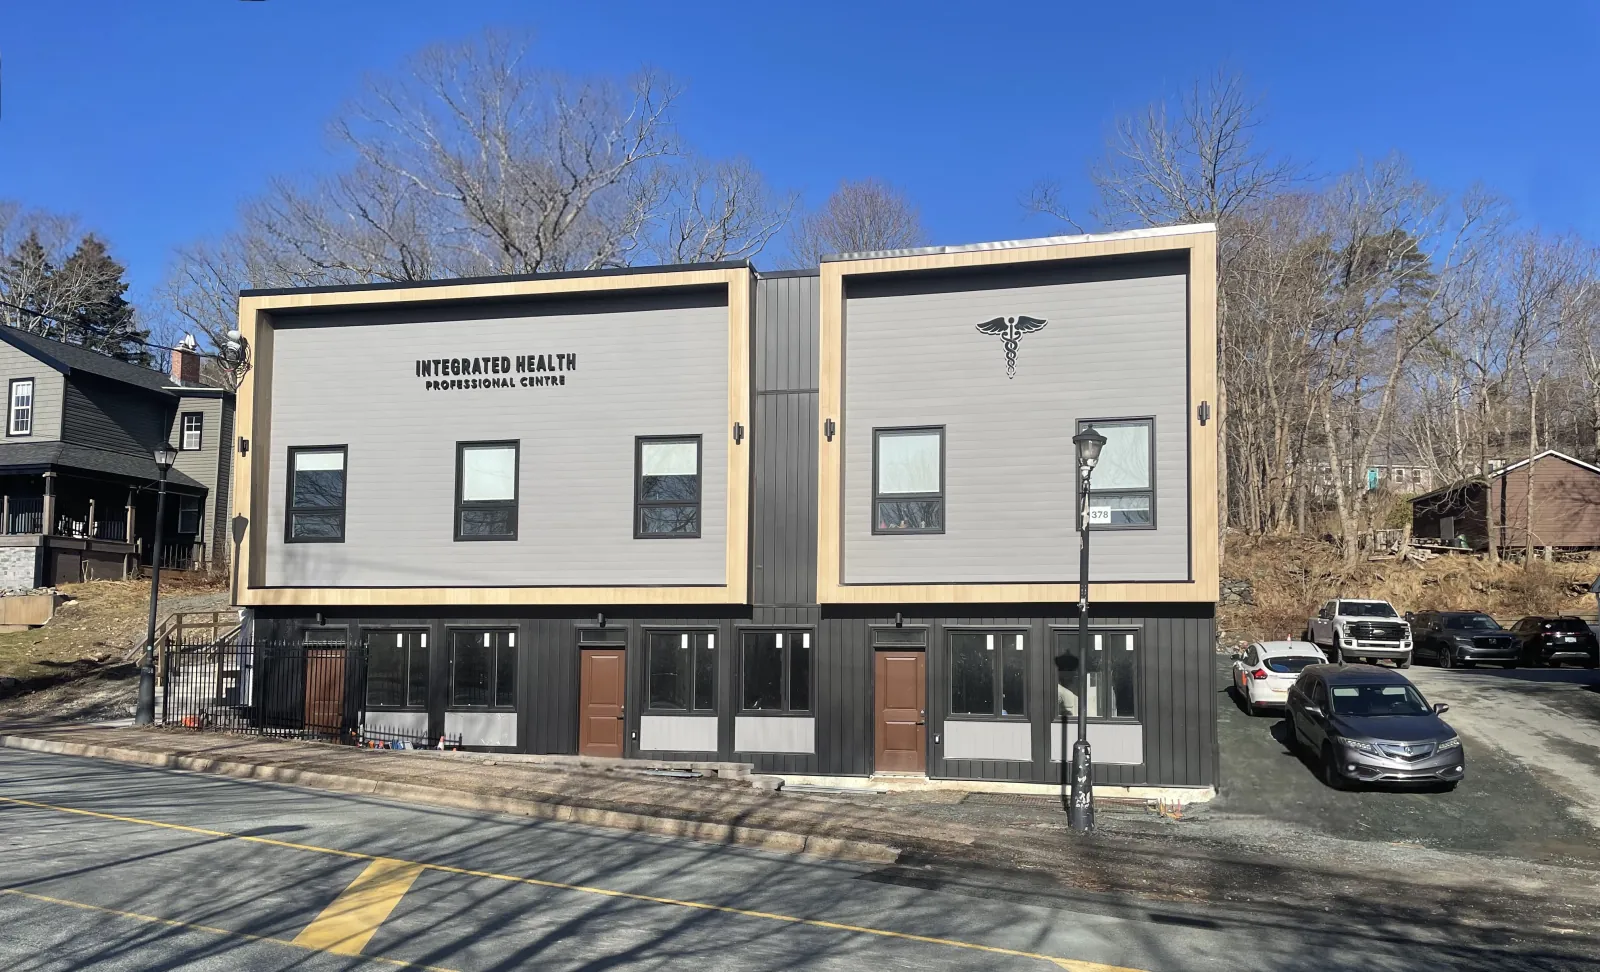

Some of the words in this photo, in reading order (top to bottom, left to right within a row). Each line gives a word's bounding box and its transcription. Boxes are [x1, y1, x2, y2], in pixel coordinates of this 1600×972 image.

[415, 355, 511, 377] INTEGRATED
[516, 353, 577, 373] HEALTH
[425, 377, 516, 391] PROFESSIONAL
[520, 375, 566, 388] CENTRE
[1091, 510, 1109, 519] 378
